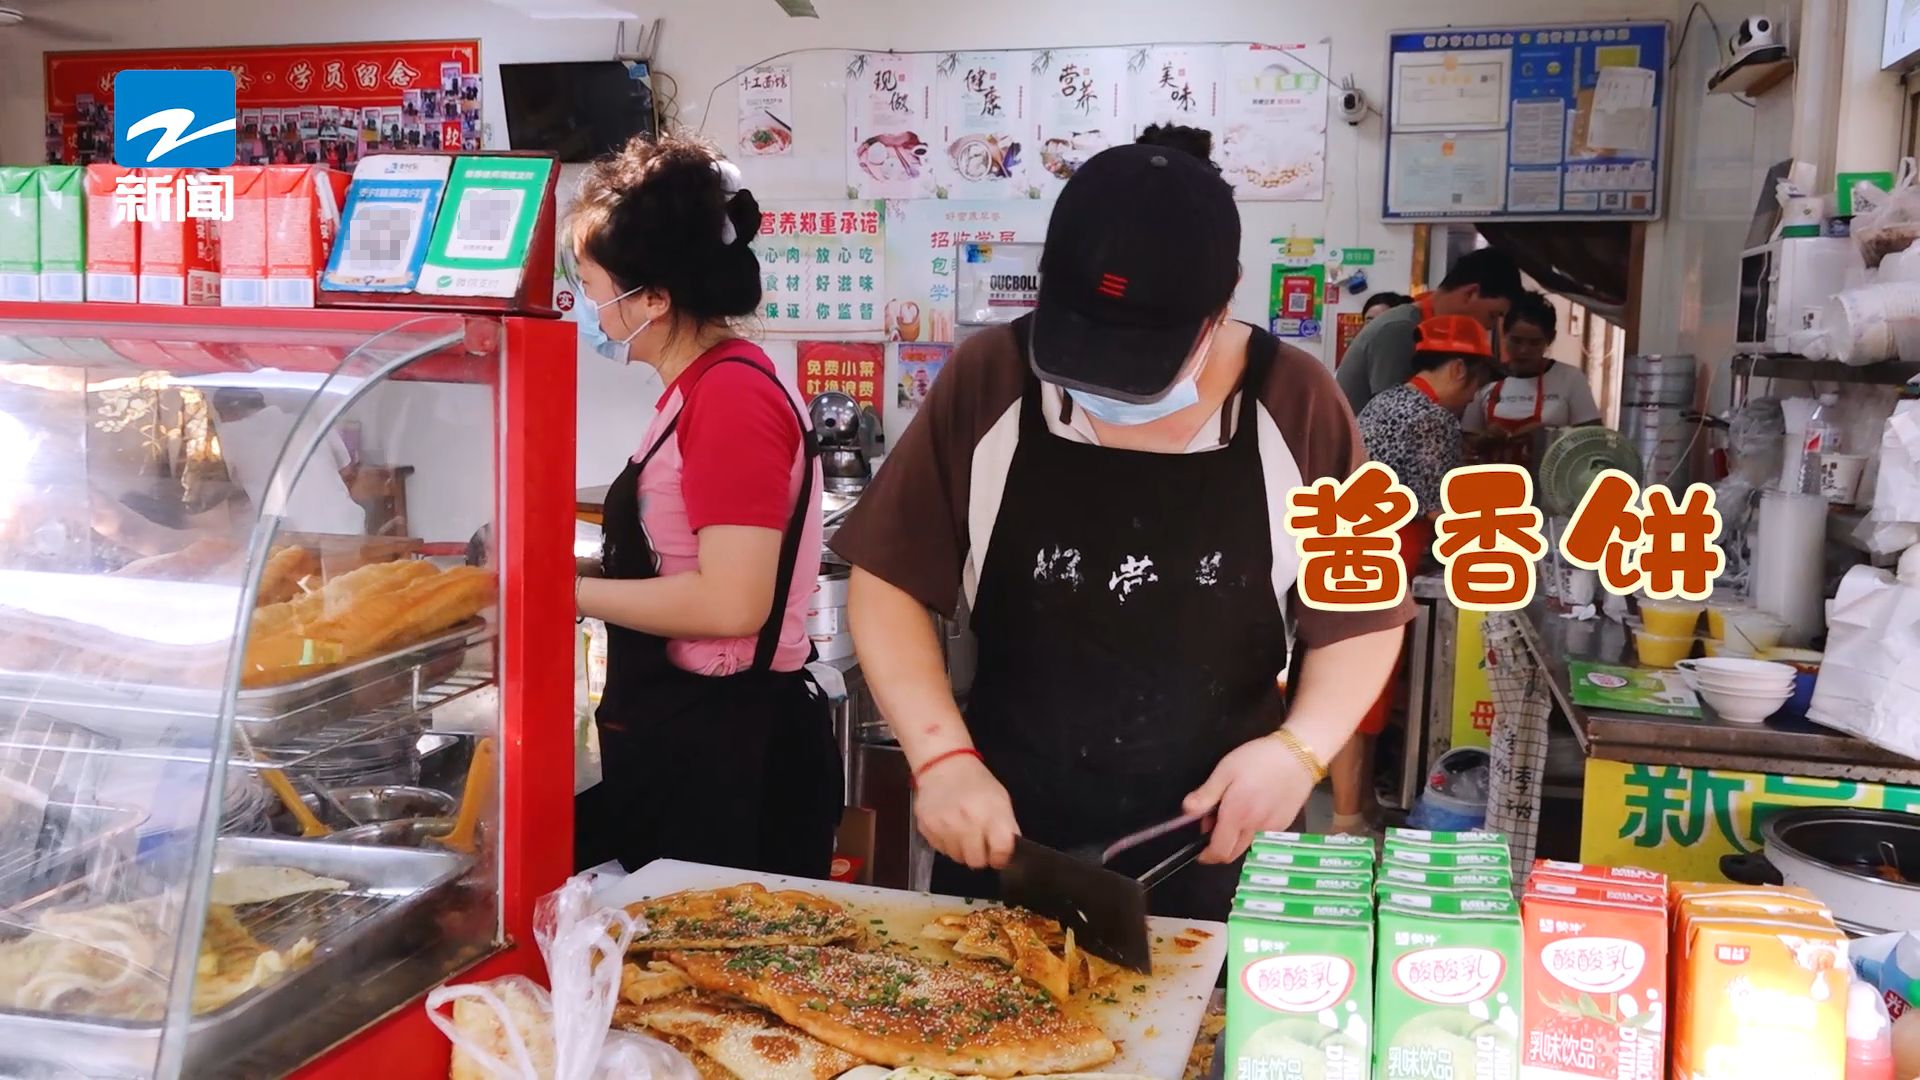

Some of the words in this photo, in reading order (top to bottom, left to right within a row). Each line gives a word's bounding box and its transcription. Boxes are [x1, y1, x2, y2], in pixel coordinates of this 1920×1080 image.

[287, 60, 420, 91] 学员留念
[1058, 63, 1099, 117] 营养
[1158, 60, 1197, 113] 美味
[964, 65, 1002, 117] 健康
[759, 210, 878, 236] 营养郑重承诺
[815, 246, 874, 264] 放心吃
[815, 273, 874, 292] 好滋味
[765, 302, 800, 319] 保证
[815, 302, 874, 320] 你监督
[806, 359, 875, 377] 免费小菜
[806, 379, 874, 398] 杜绝浪费
[1409, 954, 1491, 984] 酸酸乳
[1552, 945, 1635, 972] 酸酸乳
[1258, 960, 1339, 992] 酸酸乳
[1388, 1046, 1453, 1080] 乳味饮品
[1530, 1030, 1596, 1070] 乳味饮品
